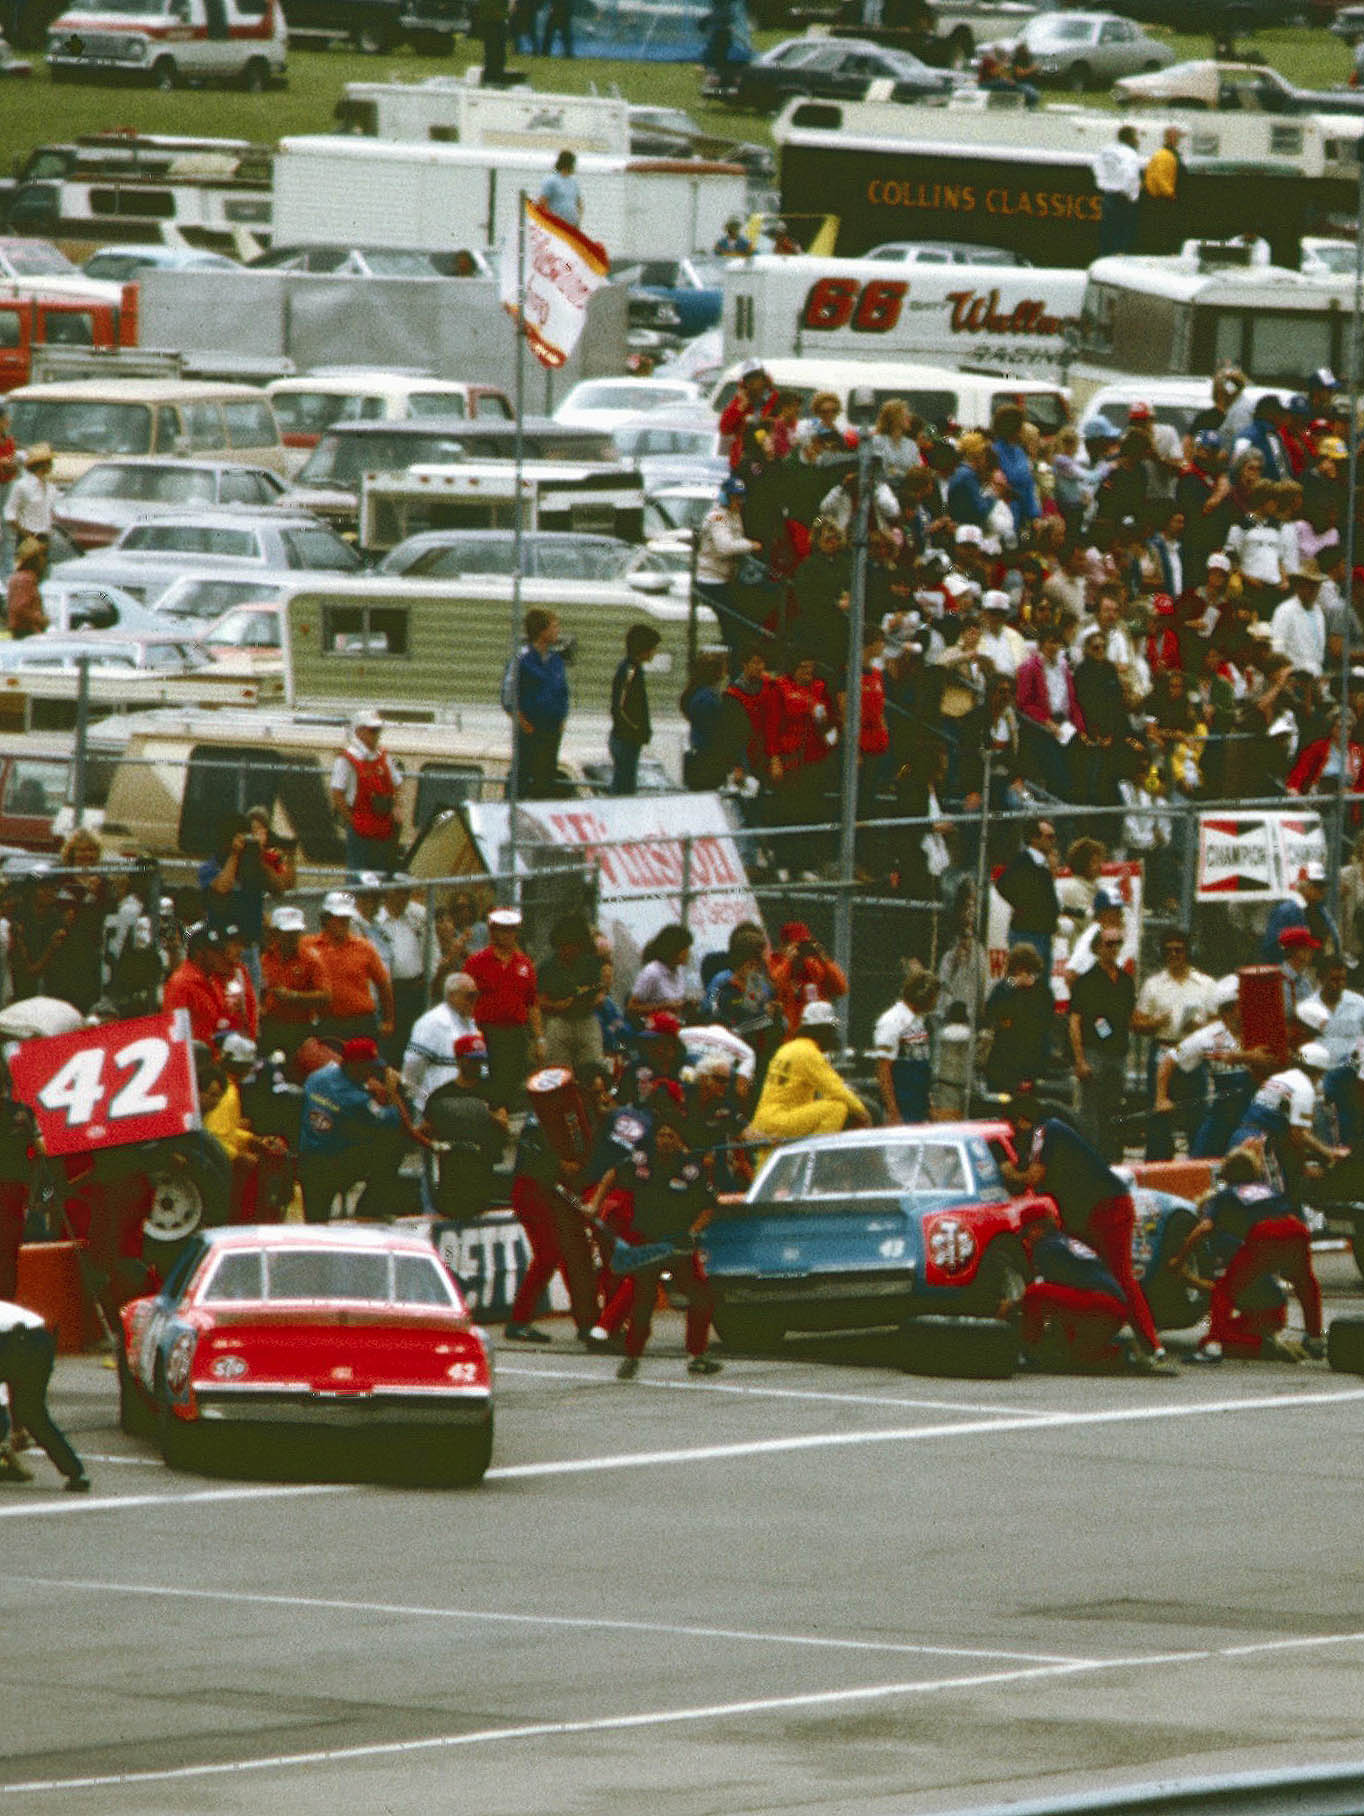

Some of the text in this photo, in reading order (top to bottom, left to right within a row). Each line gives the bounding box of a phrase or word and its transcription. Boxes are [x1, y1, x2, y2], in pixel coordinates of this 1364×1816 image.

[867, 179, 1104, 222] COLLINS CLASSICS
[801, 276, 911, 334] 66
[37, 1037, 170, 1127] 42
[931, 1219, 975, 1270] STP
[212, 1356, 247, 1379] STP
[447, 1361, 478, 1383] 42
